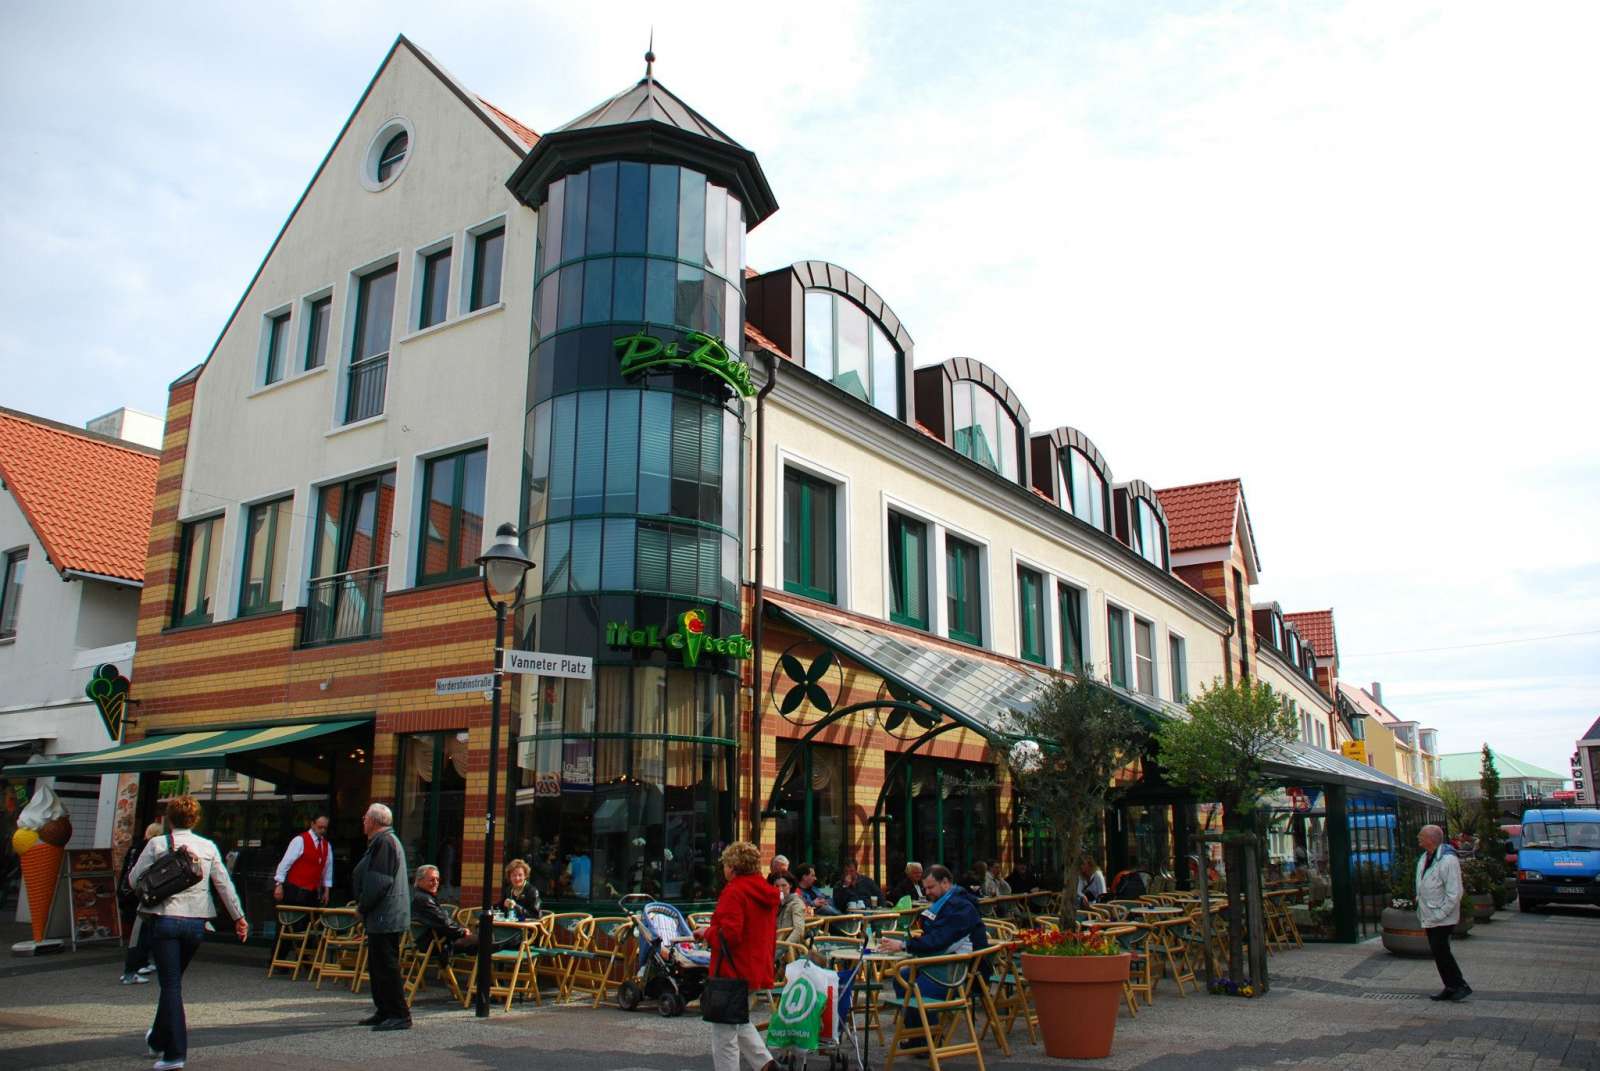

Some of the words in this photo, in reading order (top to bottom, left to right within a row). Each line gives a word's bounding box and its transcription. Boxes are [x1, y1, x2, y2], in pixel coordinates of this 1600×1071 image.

[511, 655, 557, 671] Vanneter
[561, 659, 587, 674] Platz
[437, 677, 492, 691] Nordersteinstraße
